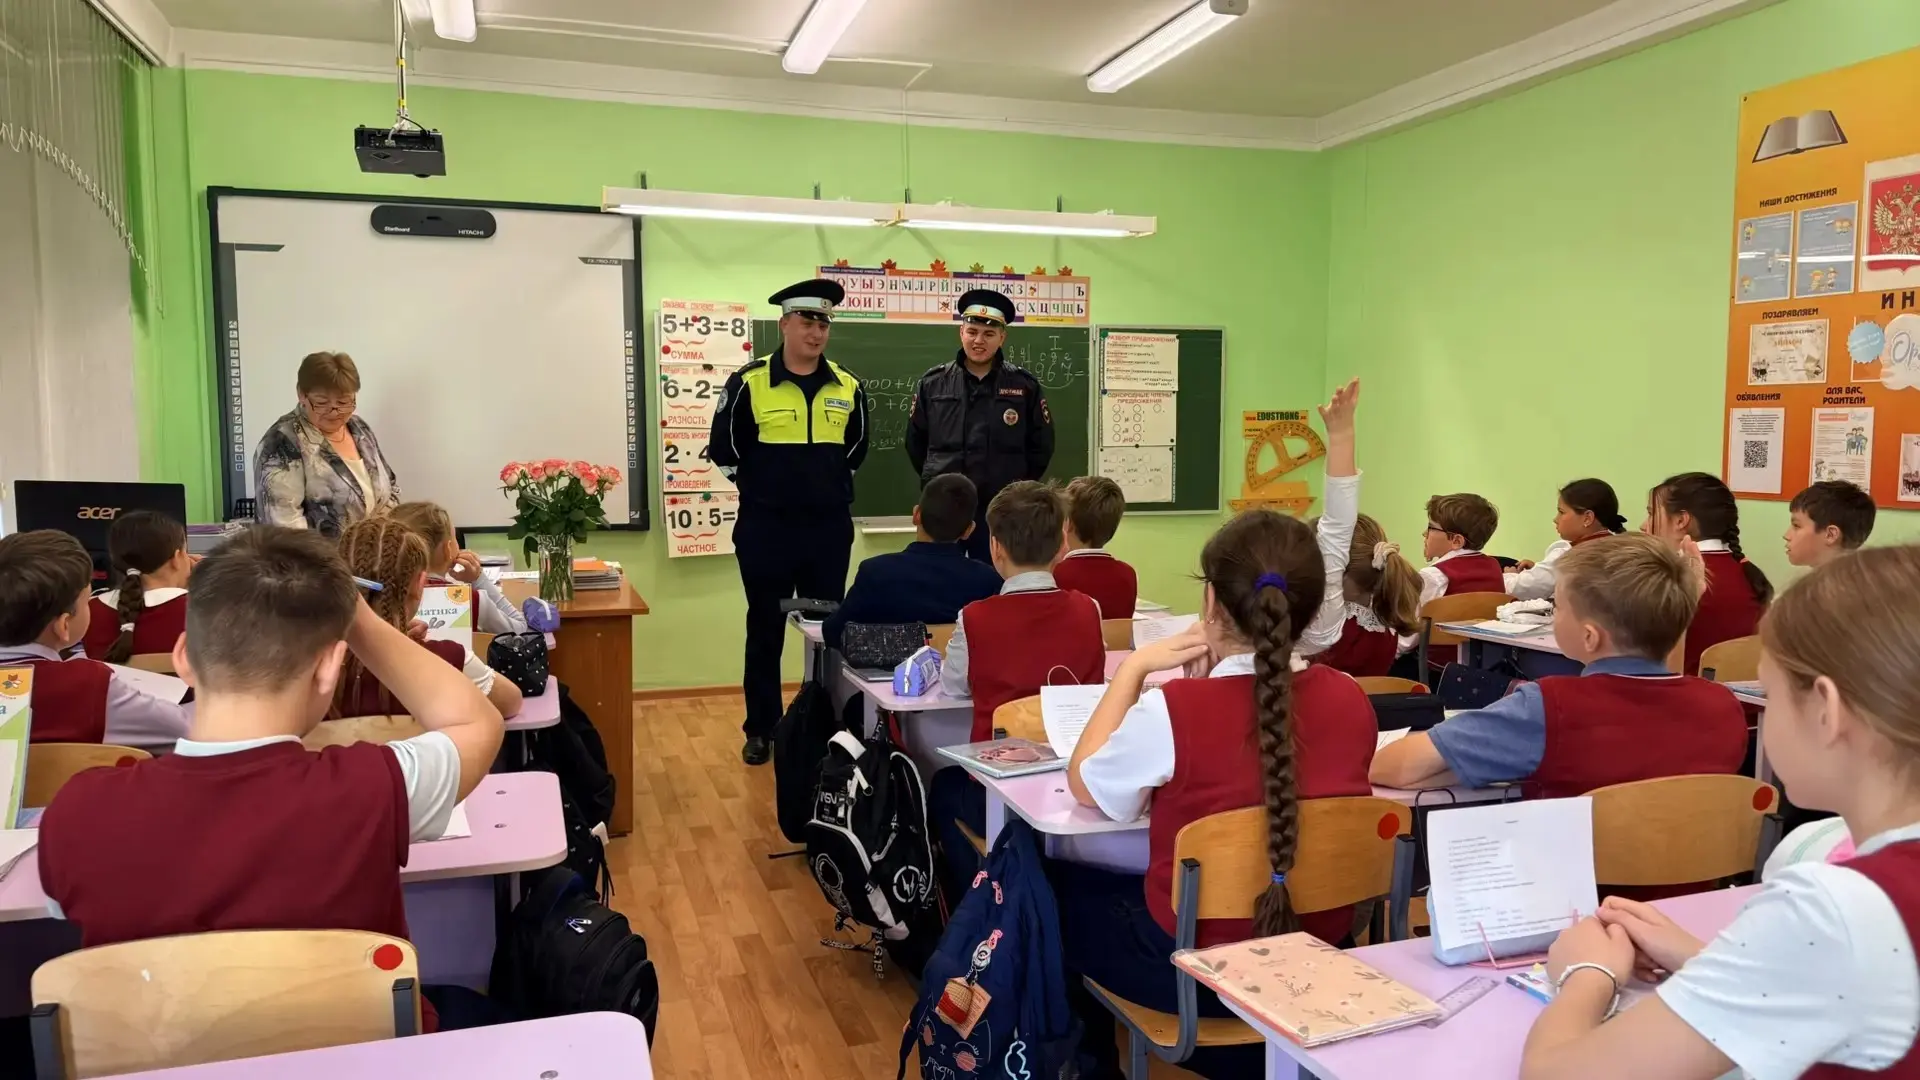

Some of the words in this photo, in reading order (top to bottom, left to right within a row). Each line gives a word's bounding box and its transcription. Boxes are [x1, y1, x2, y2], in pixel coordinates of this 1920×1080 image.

[1759, 197, 1782, 208] НАШИ
[1784, 187, 1837, 204] ДОСТИЖЕНИЯ
[1762, 307, 1819, 319] ПОЗДРАВЛЯЕМ
[671, 351, 705, 360] СУММА
[1826, 386, 1843, 395] ДЛЯ
[1822, 396, 1866, 405] РОДИТЕЛИ
[668, 415, 707, 425] РАЗНОСТЬ
[1256, 411, 1300, 421] EDUSTRONG
[665, 480, 712, 490] ПРОИЗВЕДЕНИЕ
[77, 506, 122, 519] acer
[677, 543, 717, 554] ЧАСТНОЕ
